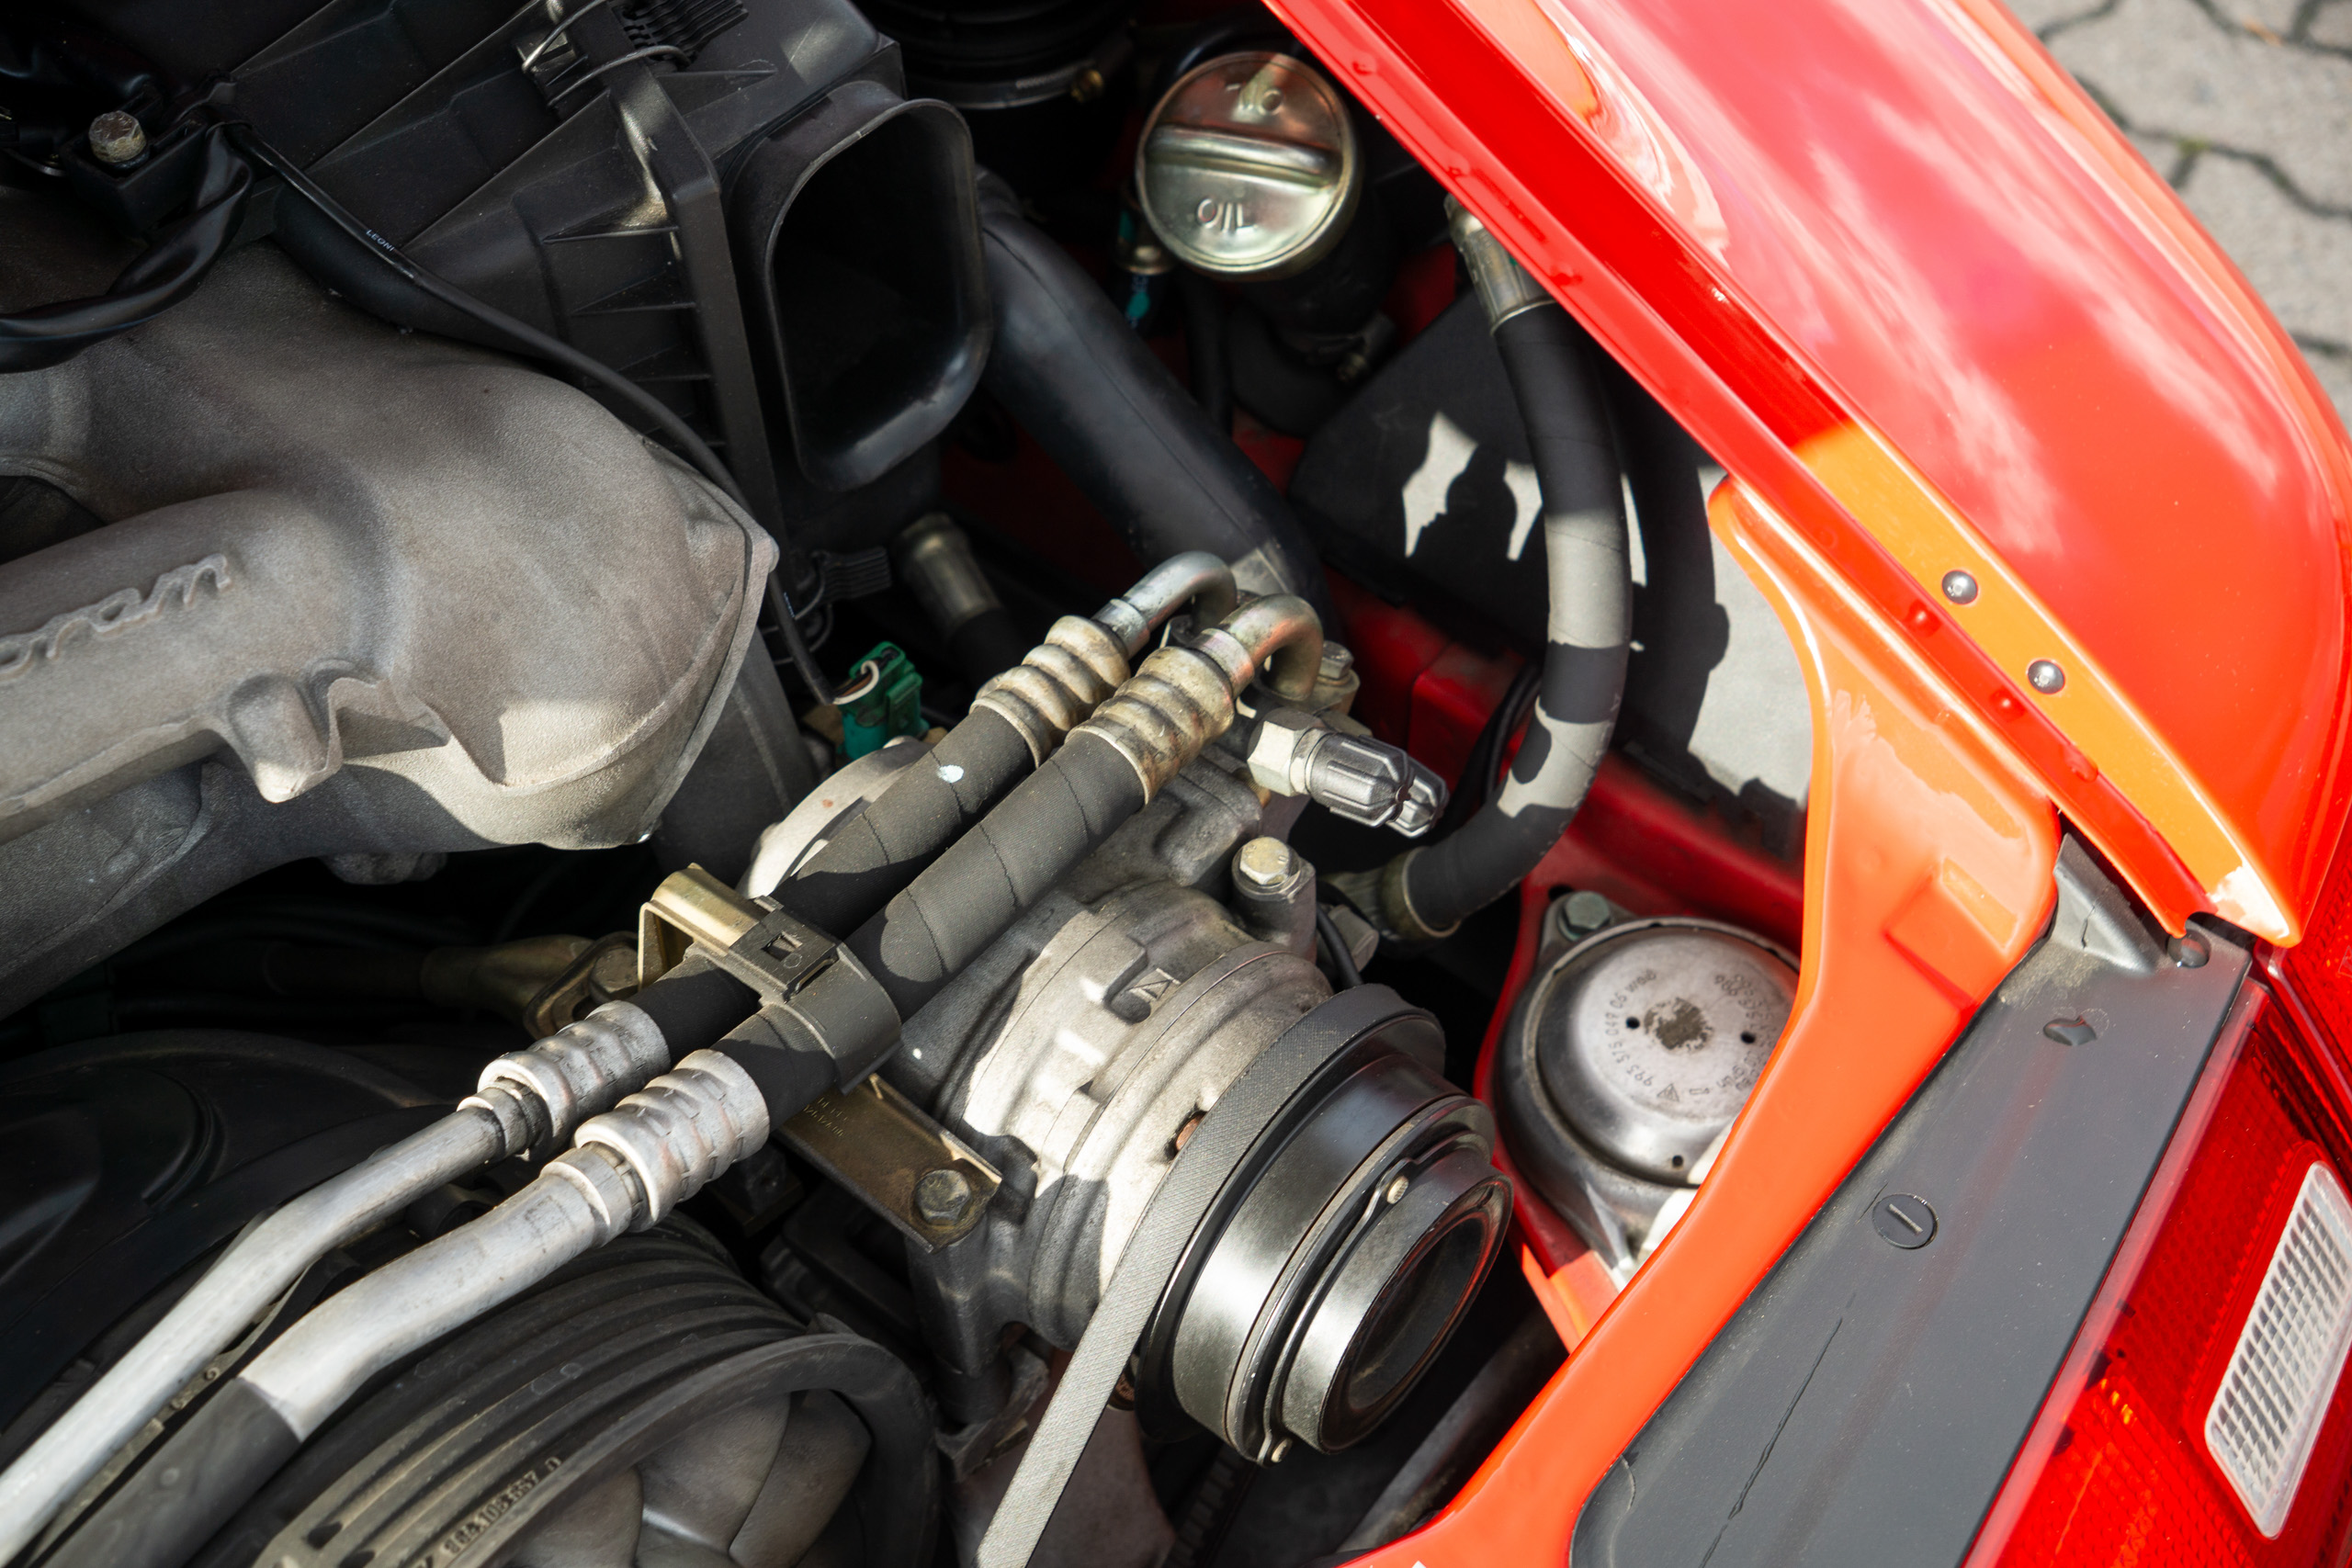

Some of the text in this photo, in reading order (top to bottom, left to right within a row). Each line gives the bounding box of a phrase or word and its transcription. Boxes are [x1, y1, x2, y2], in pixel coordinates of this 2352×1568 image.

[1197, 197, 1258, 233] OIL
[366, 229, 395, 252] LEONI
[1627, 1065, 1654, 1087] 993
